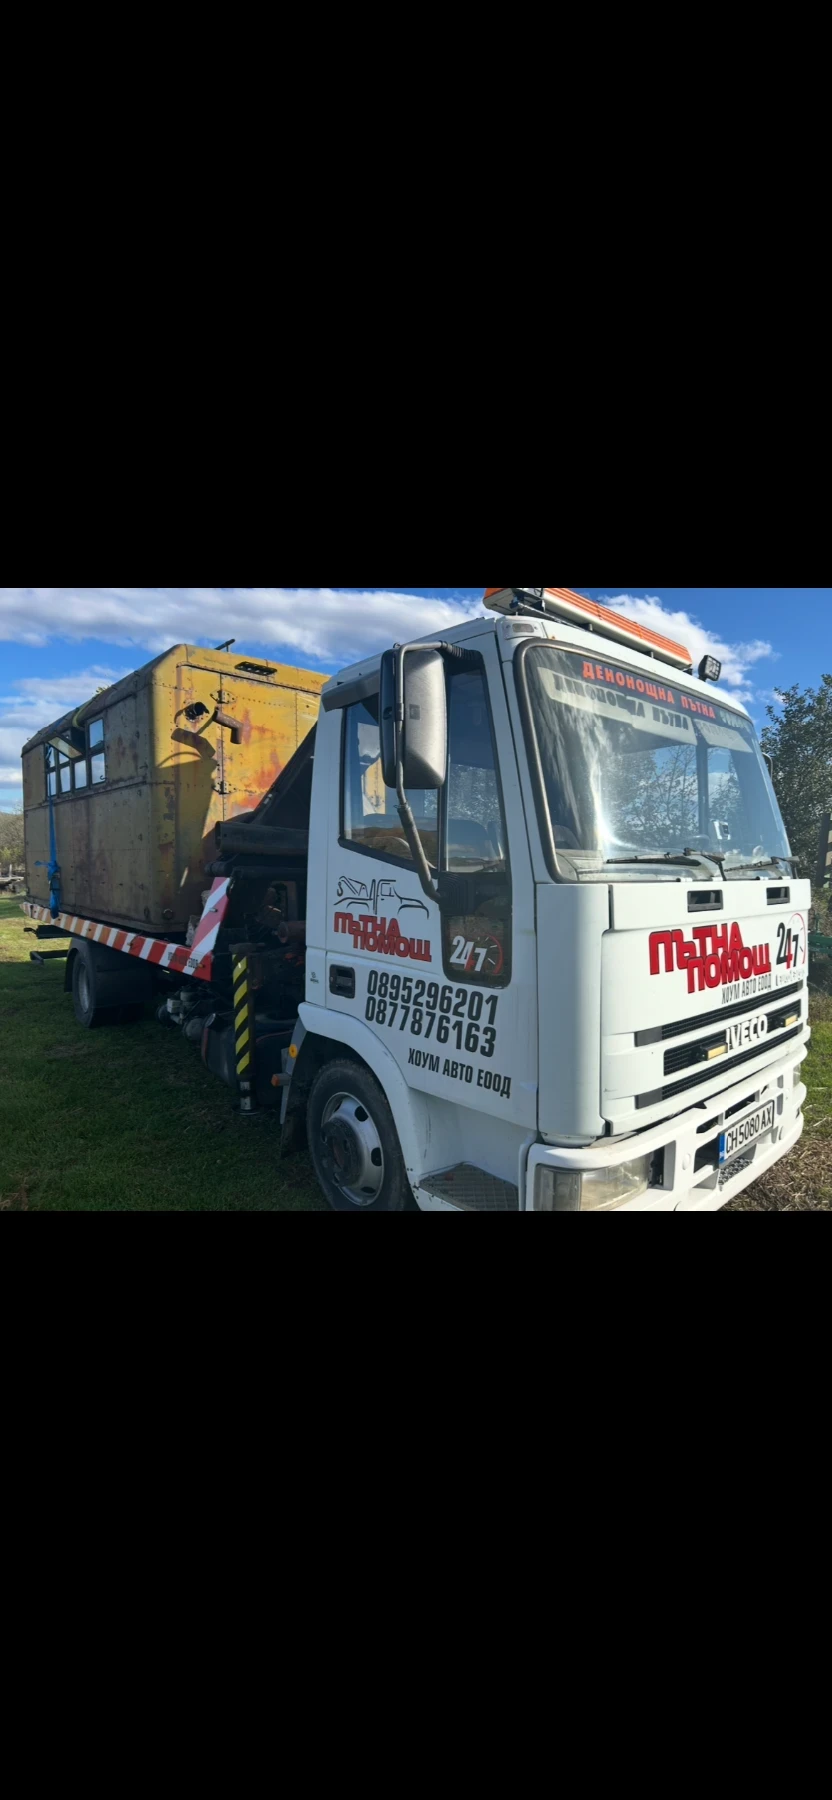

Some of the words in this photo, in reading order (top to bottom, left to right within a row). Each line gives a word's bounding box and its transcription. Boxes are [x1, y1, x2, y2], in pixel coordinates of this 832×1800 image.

[582, 661, 675, 705] ДЕНОНОЩНА
[680, 695, 716, 719] ПЪТНА
[334, 912, 401, 937] ПЪТНА
[352, 930, 432, 962] ПОМОЩ
[648, 921, 744, 976] ПЪТНА
[687, 943, 771, 994] ПОМОЩ
[721, 982, 740, 1005] ХОУМ
[741, 978, 757, 997] АВТО
[367, 970, 499, 1026] 0895296201
[365, 996, 497, 1058] 0877876163
[726, 1014, 768, 1051] IVECO
[408, 1048, 440, 1073] ХОУМ
[442, 1059, 473, 1084] АВТО
[477, 1069, 512, 1099] ЕООД
